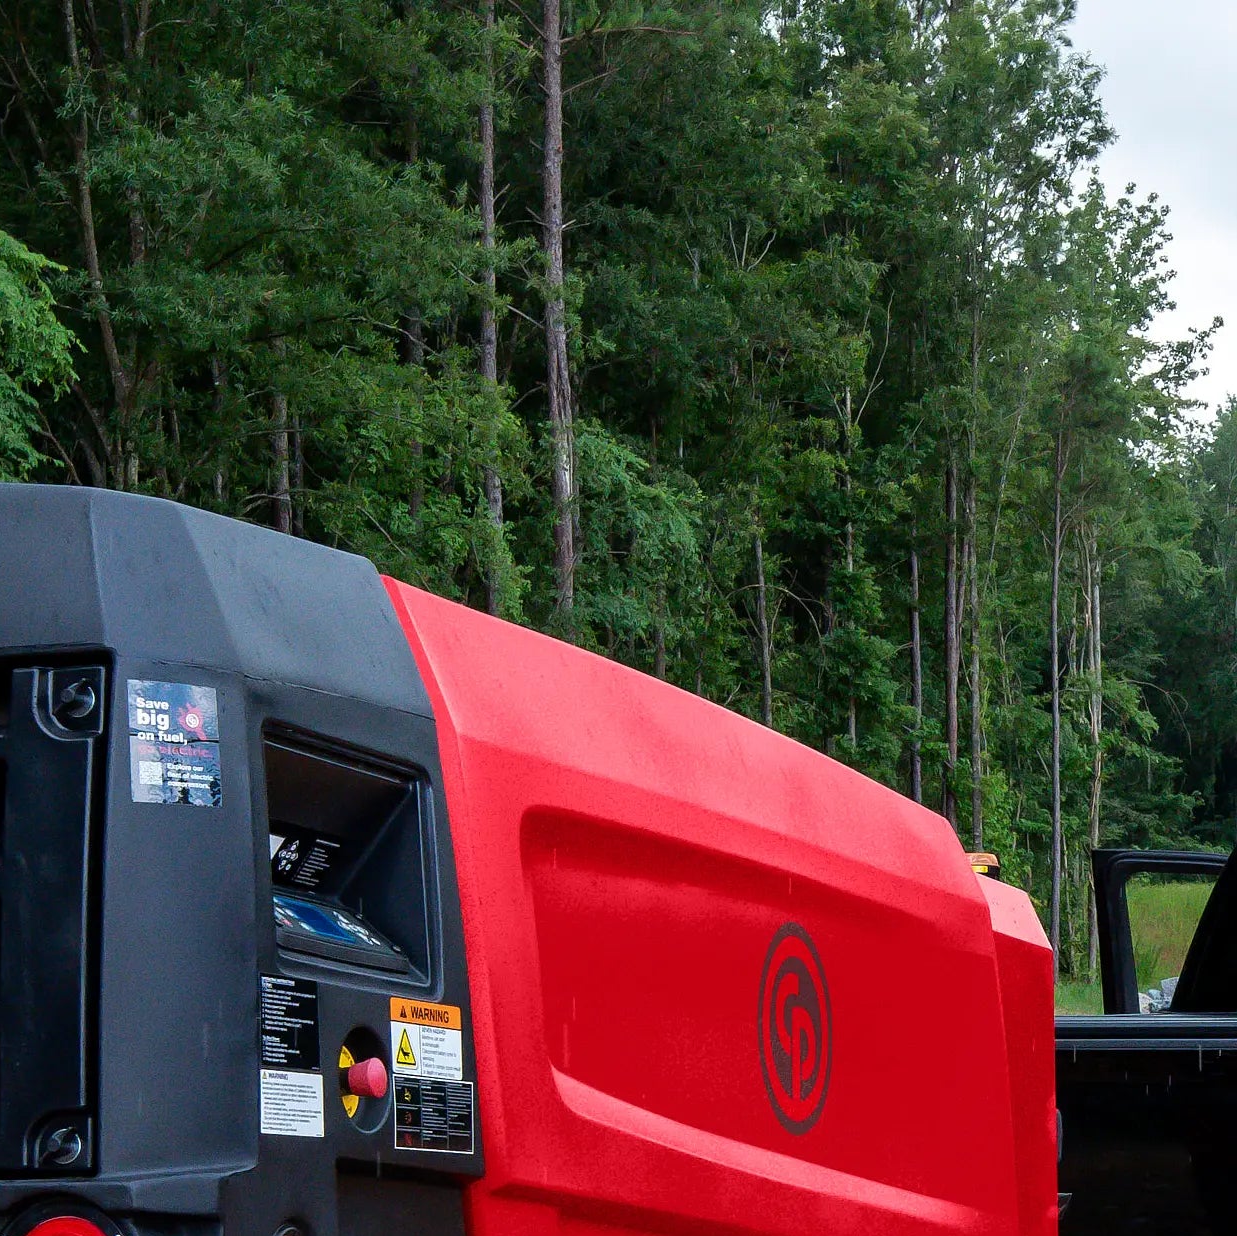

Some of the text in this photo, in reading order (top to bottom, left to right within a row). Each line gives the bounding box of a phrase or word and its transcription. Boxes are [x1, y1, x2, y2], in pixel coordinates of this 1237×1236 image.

[136, 697, 169, 710] Save
[137, 709, 170, 730] big
[137, 732, 187, 745] on fuel,
[410, 1006, 449, 1024] WARNING
